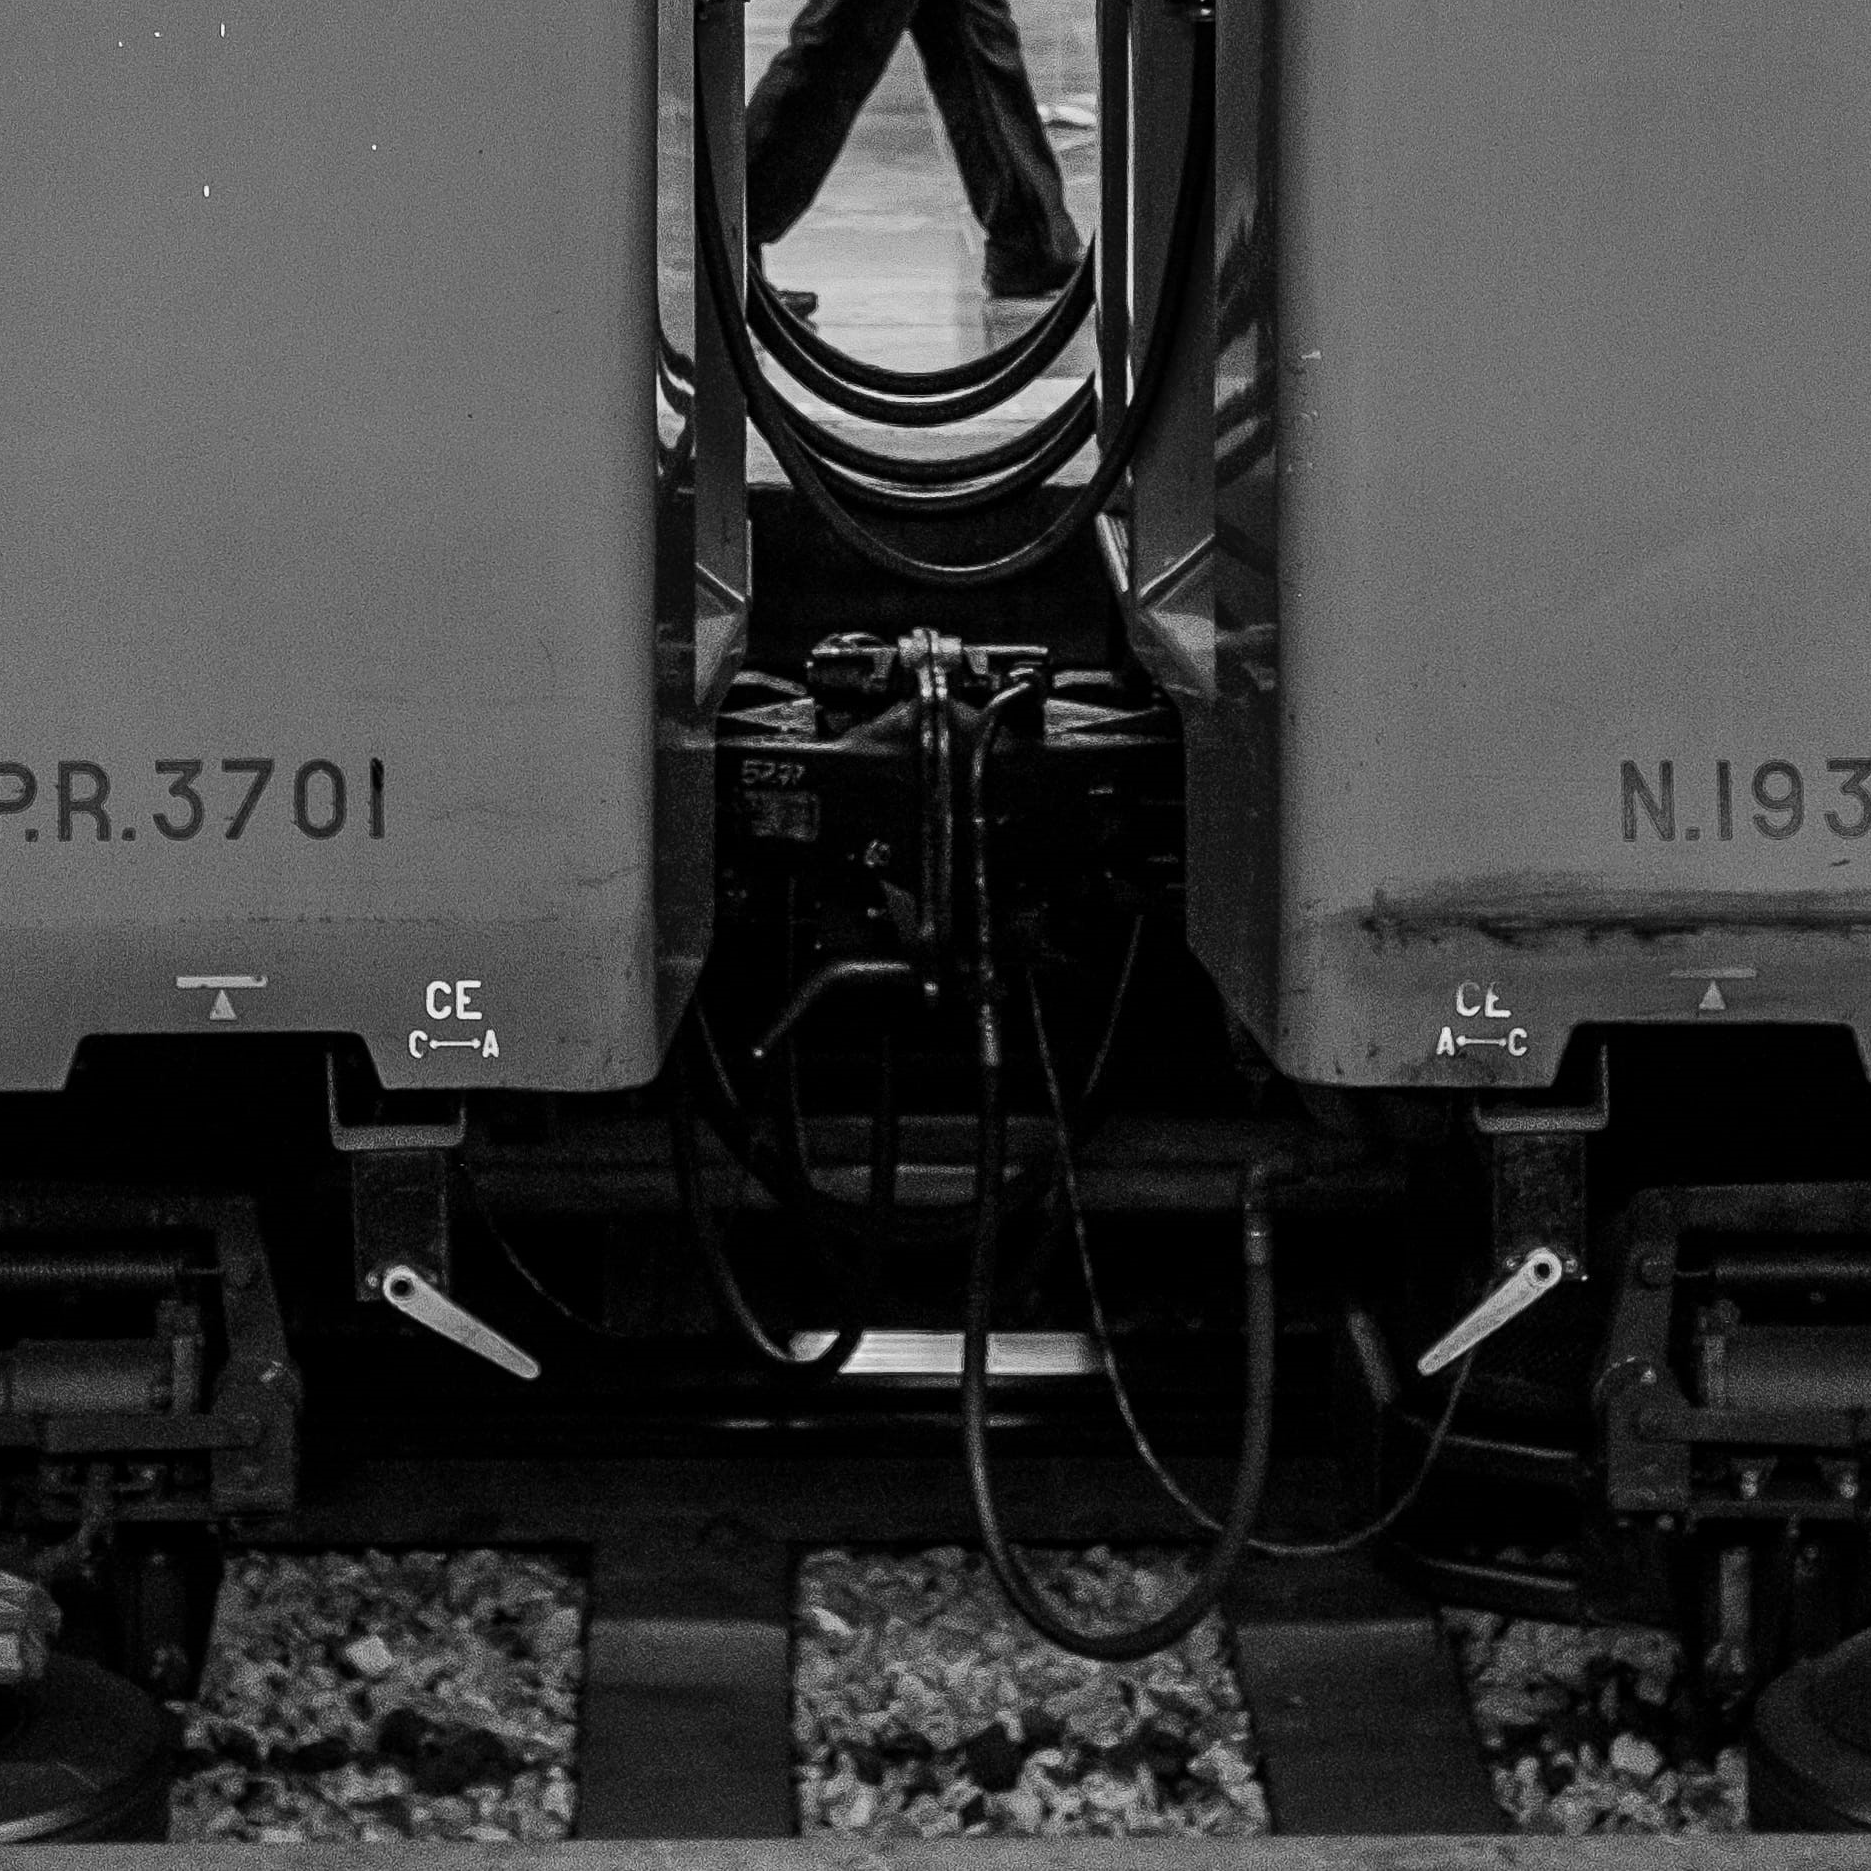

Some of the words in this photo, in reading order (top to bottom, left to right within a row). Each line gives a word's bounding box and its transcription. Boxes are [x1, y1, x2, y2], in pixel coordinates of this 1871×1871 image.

[426, 980, 482, 1021] CE
[408, 1031, 428, 1059] C
[482, 1031, 500, 1059] A
[1436, 1026, 1455, 1056] A
[1508, 1027, 1528, 1057] C
